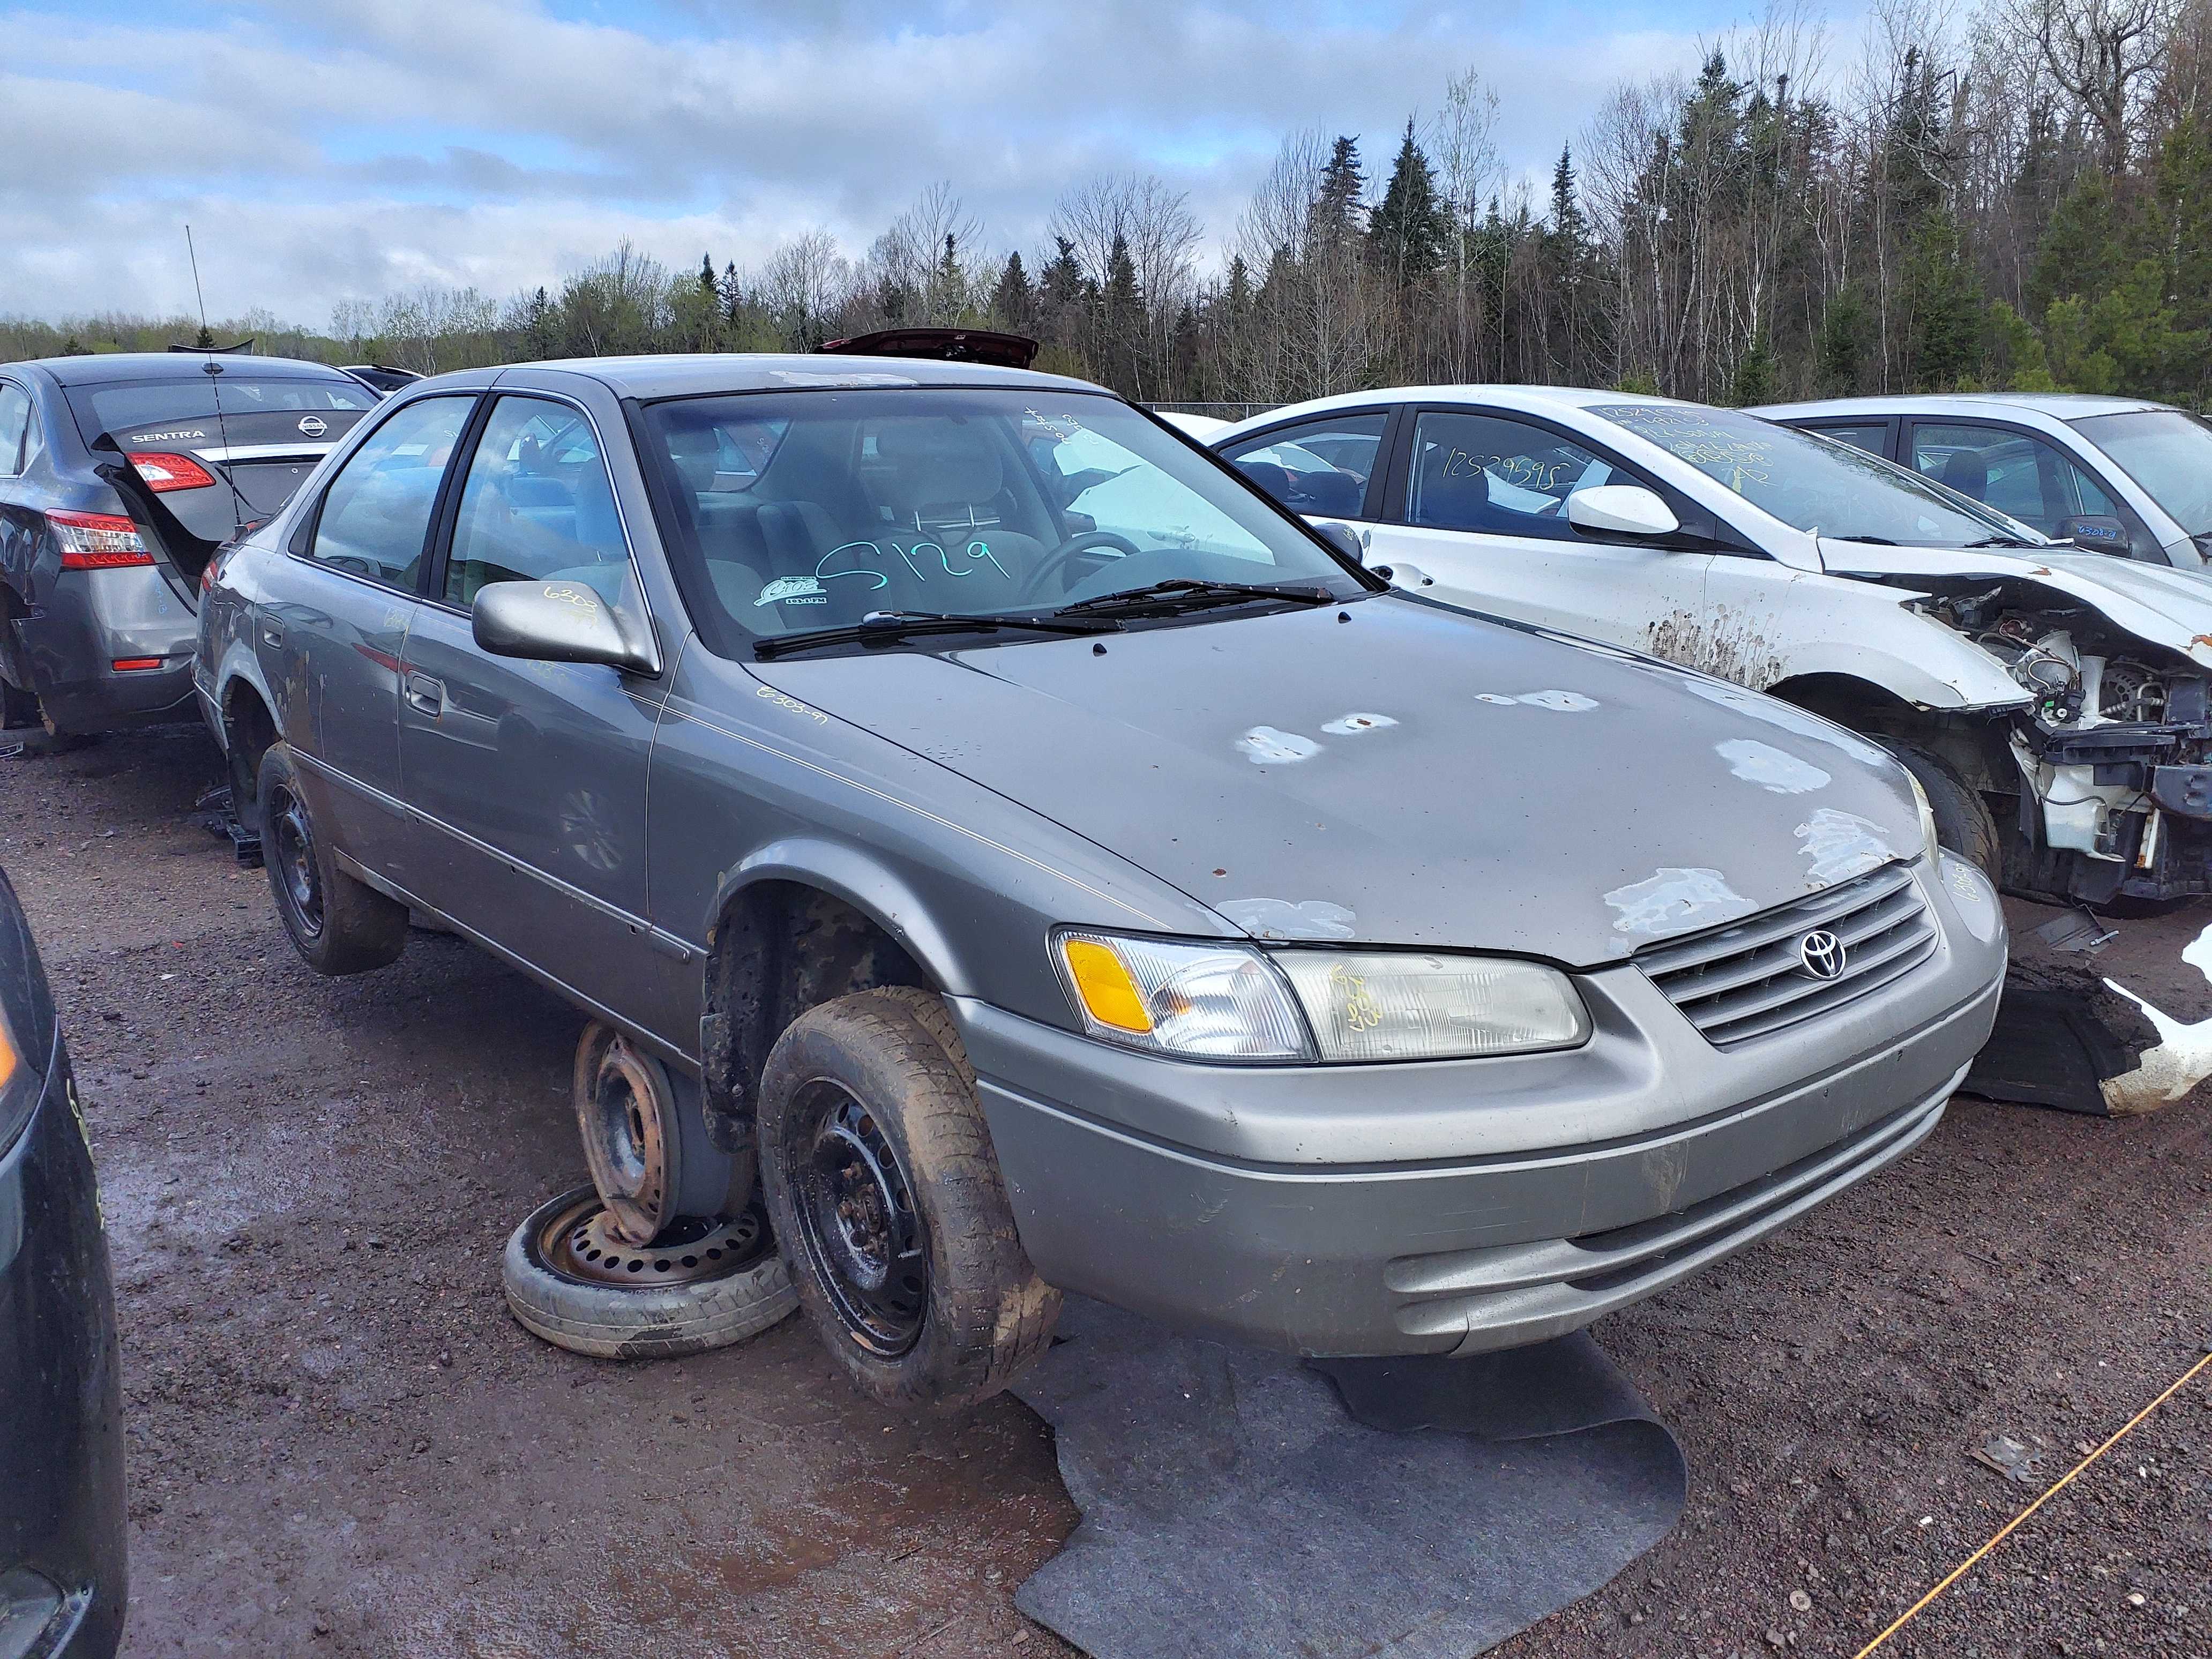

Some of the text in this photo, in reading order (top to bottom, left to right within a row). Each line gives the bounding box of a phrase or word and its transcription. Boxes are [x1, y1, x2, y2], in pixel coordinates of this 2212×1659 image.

[131, 430, 206, 443] SENTRA
[1443, 447, 1571, 490] 12529595
[816, 541, 1011, 591] S129
